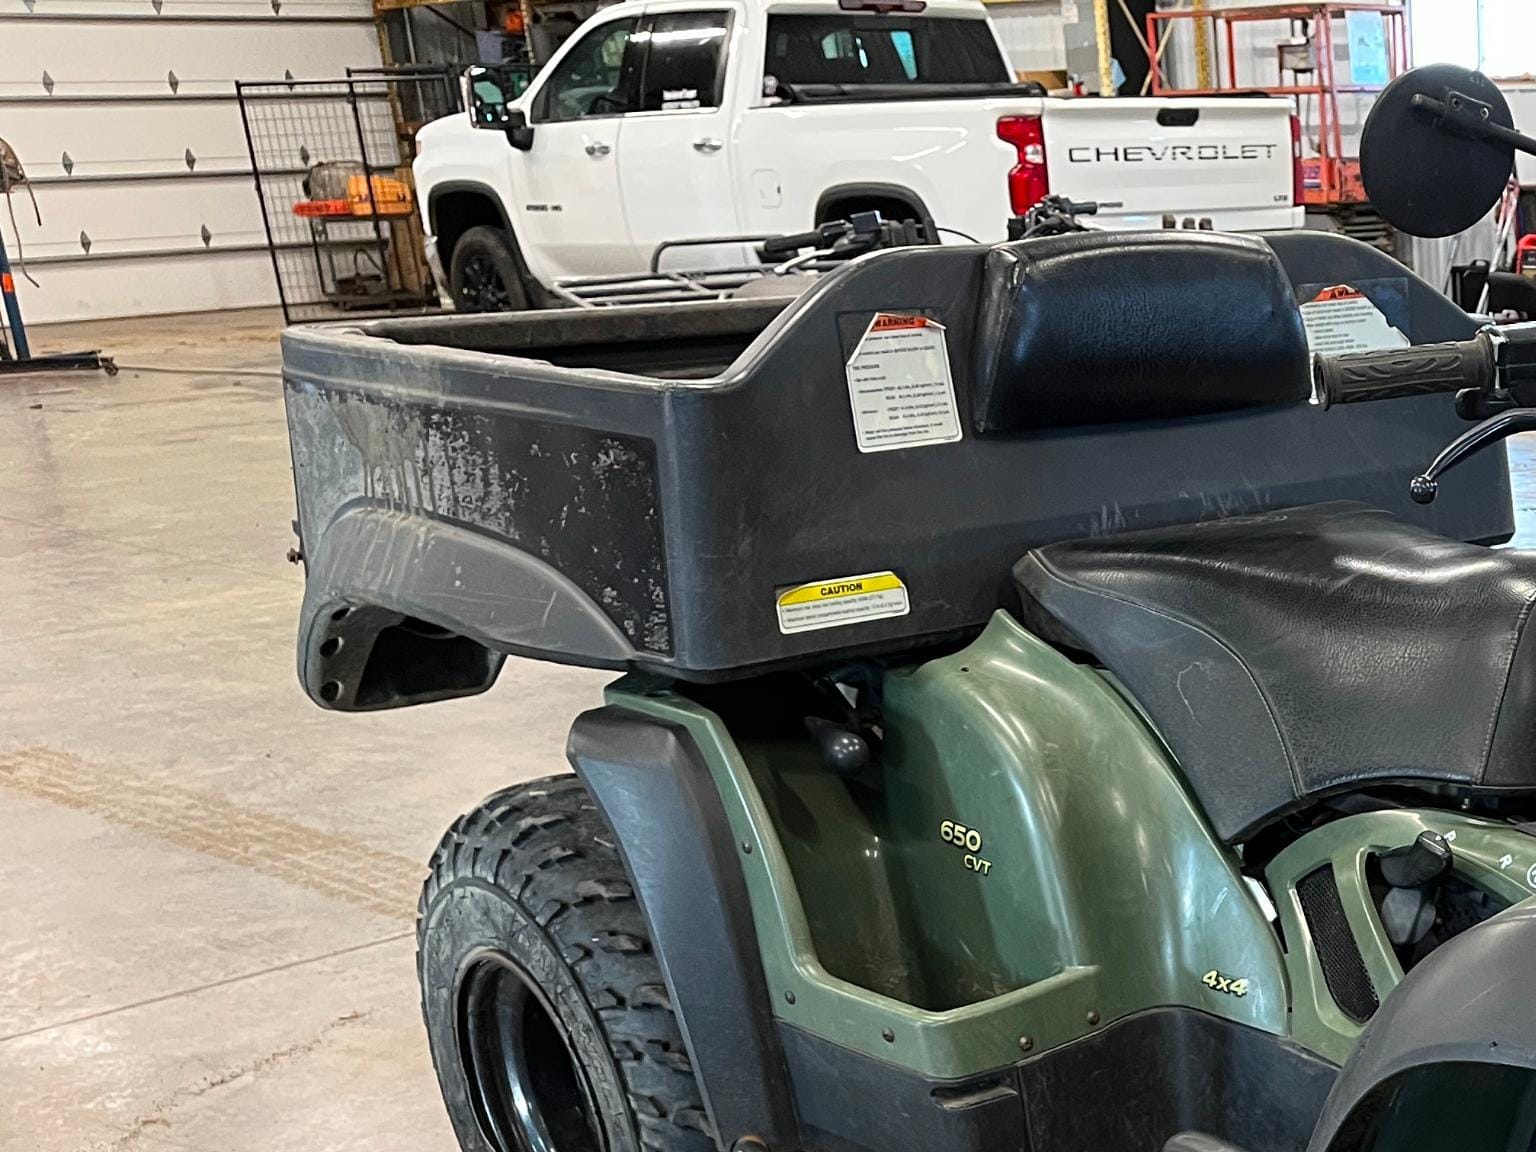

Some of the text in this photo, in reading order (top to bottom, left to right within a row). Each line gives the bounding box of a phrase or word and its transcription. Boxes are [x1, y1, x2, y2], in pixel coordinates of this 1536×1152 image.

[1068, 143, 1278, 163] CHEVROLET
[820, 582, 863, 597] CAUTION
[940, 820, 982, 853] 650
[963, 854, 992, 876] CVT
[1498, 854, 1513, 869] R
[1202, 970, 1249, 997] 4x4
